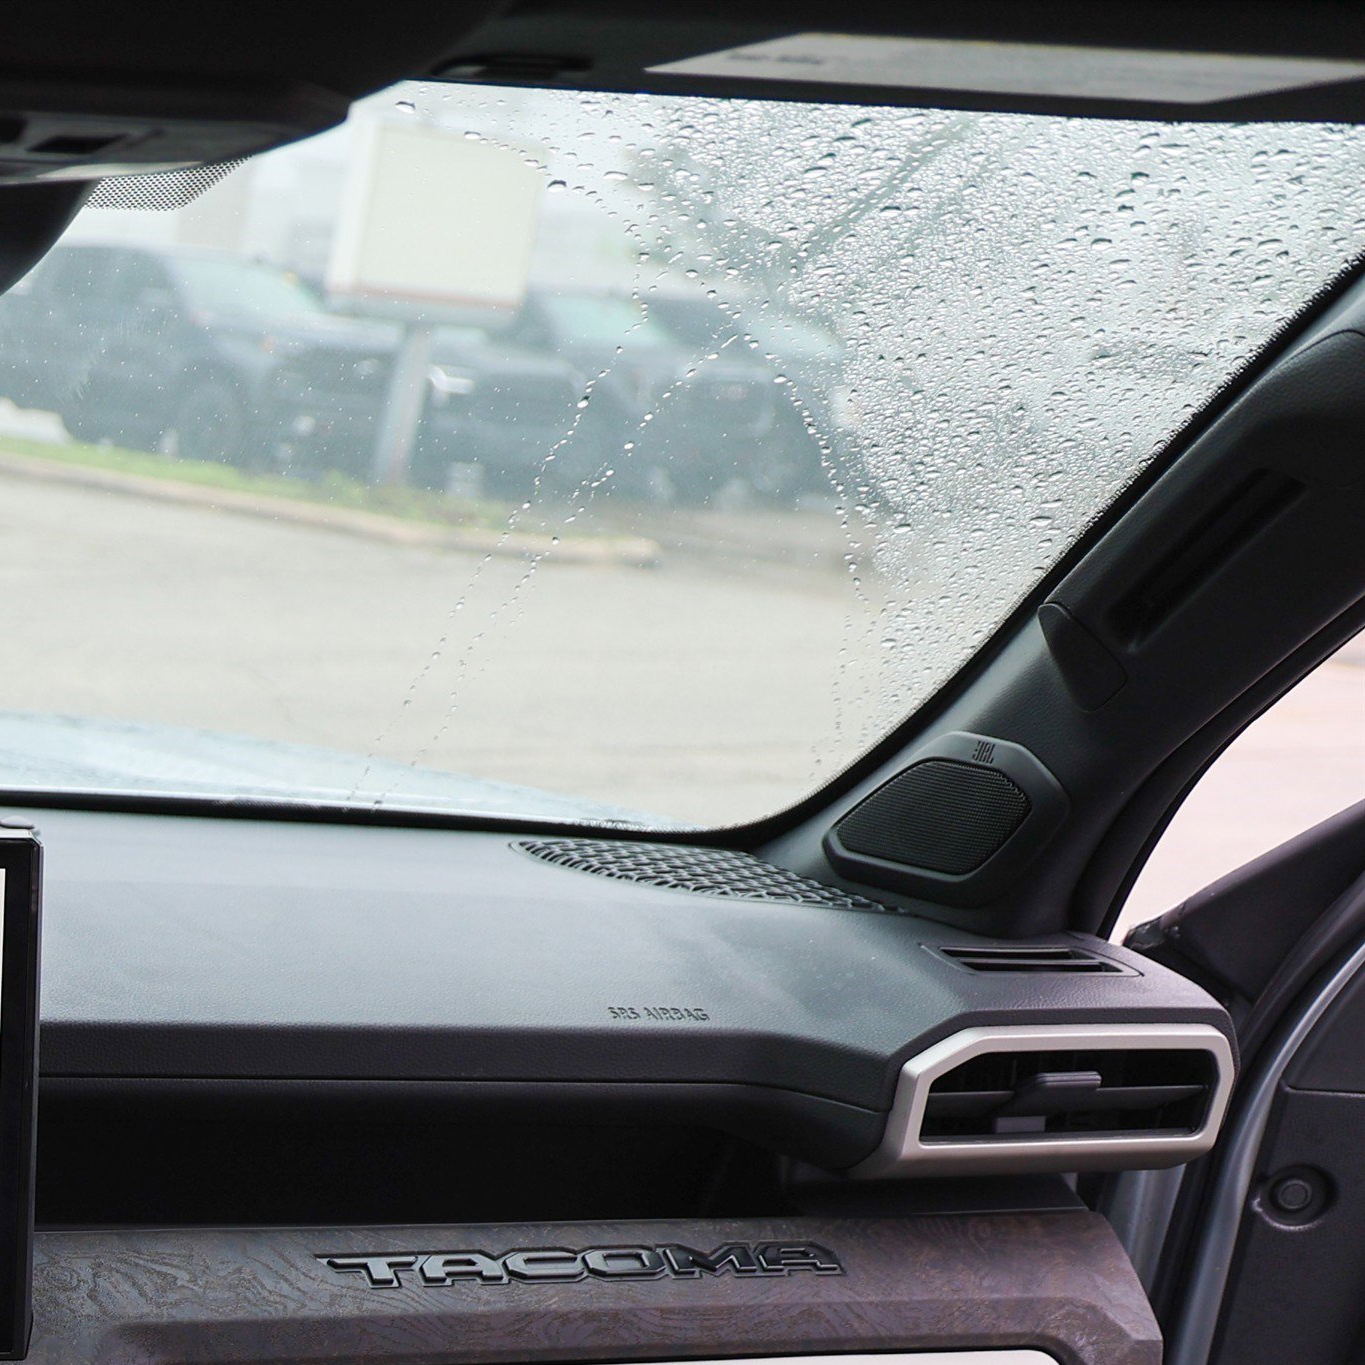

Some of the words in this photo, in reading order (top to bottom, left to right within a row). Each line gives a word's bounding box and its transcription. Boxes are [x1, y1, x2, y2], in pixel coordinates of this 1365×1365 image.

[607, 1006, 642, 1020] SRS
[643, 1006, 711, 1022] AIRBAG
[315, 1240, 847, 1290] TACOMA
